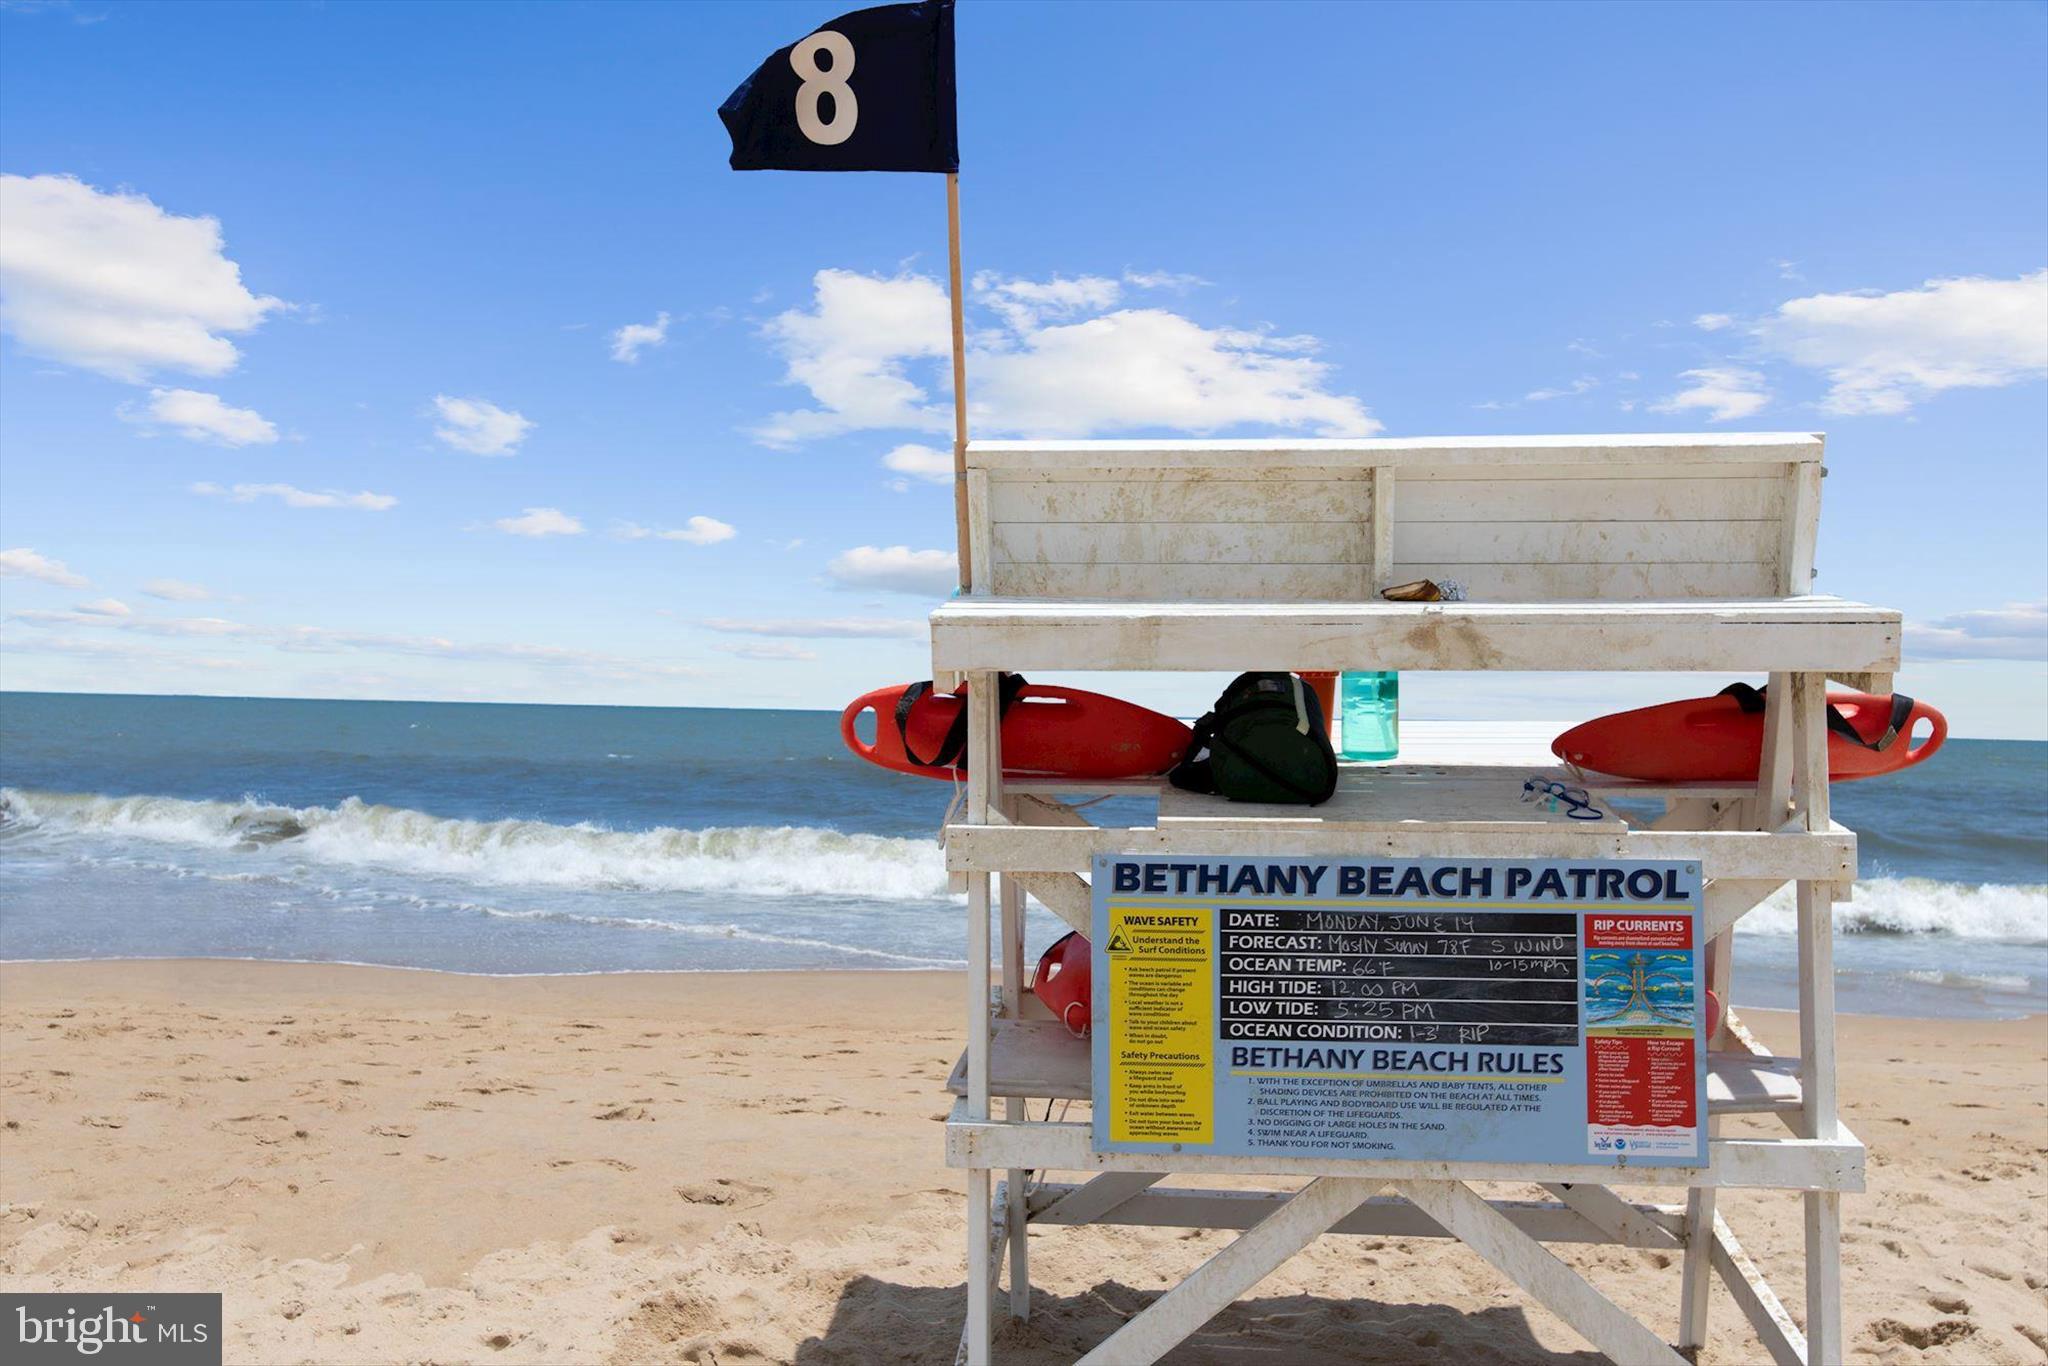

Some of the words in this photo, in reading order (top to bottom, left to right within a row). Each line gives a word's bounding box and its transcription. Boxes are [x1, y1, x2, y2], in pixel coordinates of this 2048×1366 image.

[790, 30, 858, 146] 8
[1112, 863, 1328, 895] BETHANY
[1337, 866, 1492, 898] BEACH
[1504, 868, 1689, 900] PATROL
[1124, 916, 1155, 925] WAVE
[1157, 917, 1198, 926] SAFETY
[1229, 914, 1279, 926] DATE:
[1306, 912, 1384, 932] MONDAY,
[1390, 914, 1446, 933] JUNE
[1456, 916, 1474, 933] 14
[1594, 920, 1615, 930] RIP
[1616, 920, 1684, 931] CURRENTS
[1133, 936, 1184, 945] Understand
[1229, 936, 1321, 950] FORECAST:
[1329, 935, 1378, 954] Mostly
[1384, 938, 1428, 955] Sunny
[1491, 940, 1505, 953] S
[1229, 958, 1291, 971] OCEAN
[1296, 959, 1346, 972] TEMP:
[1229, 980, 1274, 994] HIGH
[1278, 981, 1321, 995] TIDE:
[1392, 981, 1420, 996] PM
[1229, 1001, 1272, 1014] LOW
[1275, 1002, 1318, 1015] TIDE:
[1334, 1001, 1393, 1019] 5:25
[1402, 1003, 1436, 1020] PM
[1230, 1023, 1292, 1037] OCEAN
[1296, 1024, 1402, 1039] CONDITION:
[1459, 1024, 1490, 1043] RIP
[1121, 1051, 1147, 1060] Safety
[1232, 1046, 1365, 1069] BETHANY
[1372, 1050, 1468, 1071] BEACH
[1478, 1052, 1564, 1074] RULES
[1301, 1078, 1350, 1087] EXCEPTION
[1351, 1080, 1364, 1088] OF
[1366, 1080, 1417, 1088] UMBRELLAS
[1359, 1090, 1412, 1098] PROHIBITED
[1260, 1108, 1311, 1116] DISCRETION
[1342, 1100, 1398, 1108] BODYBOARD
[1455, 1103, 1508, 1111] REGULATED
